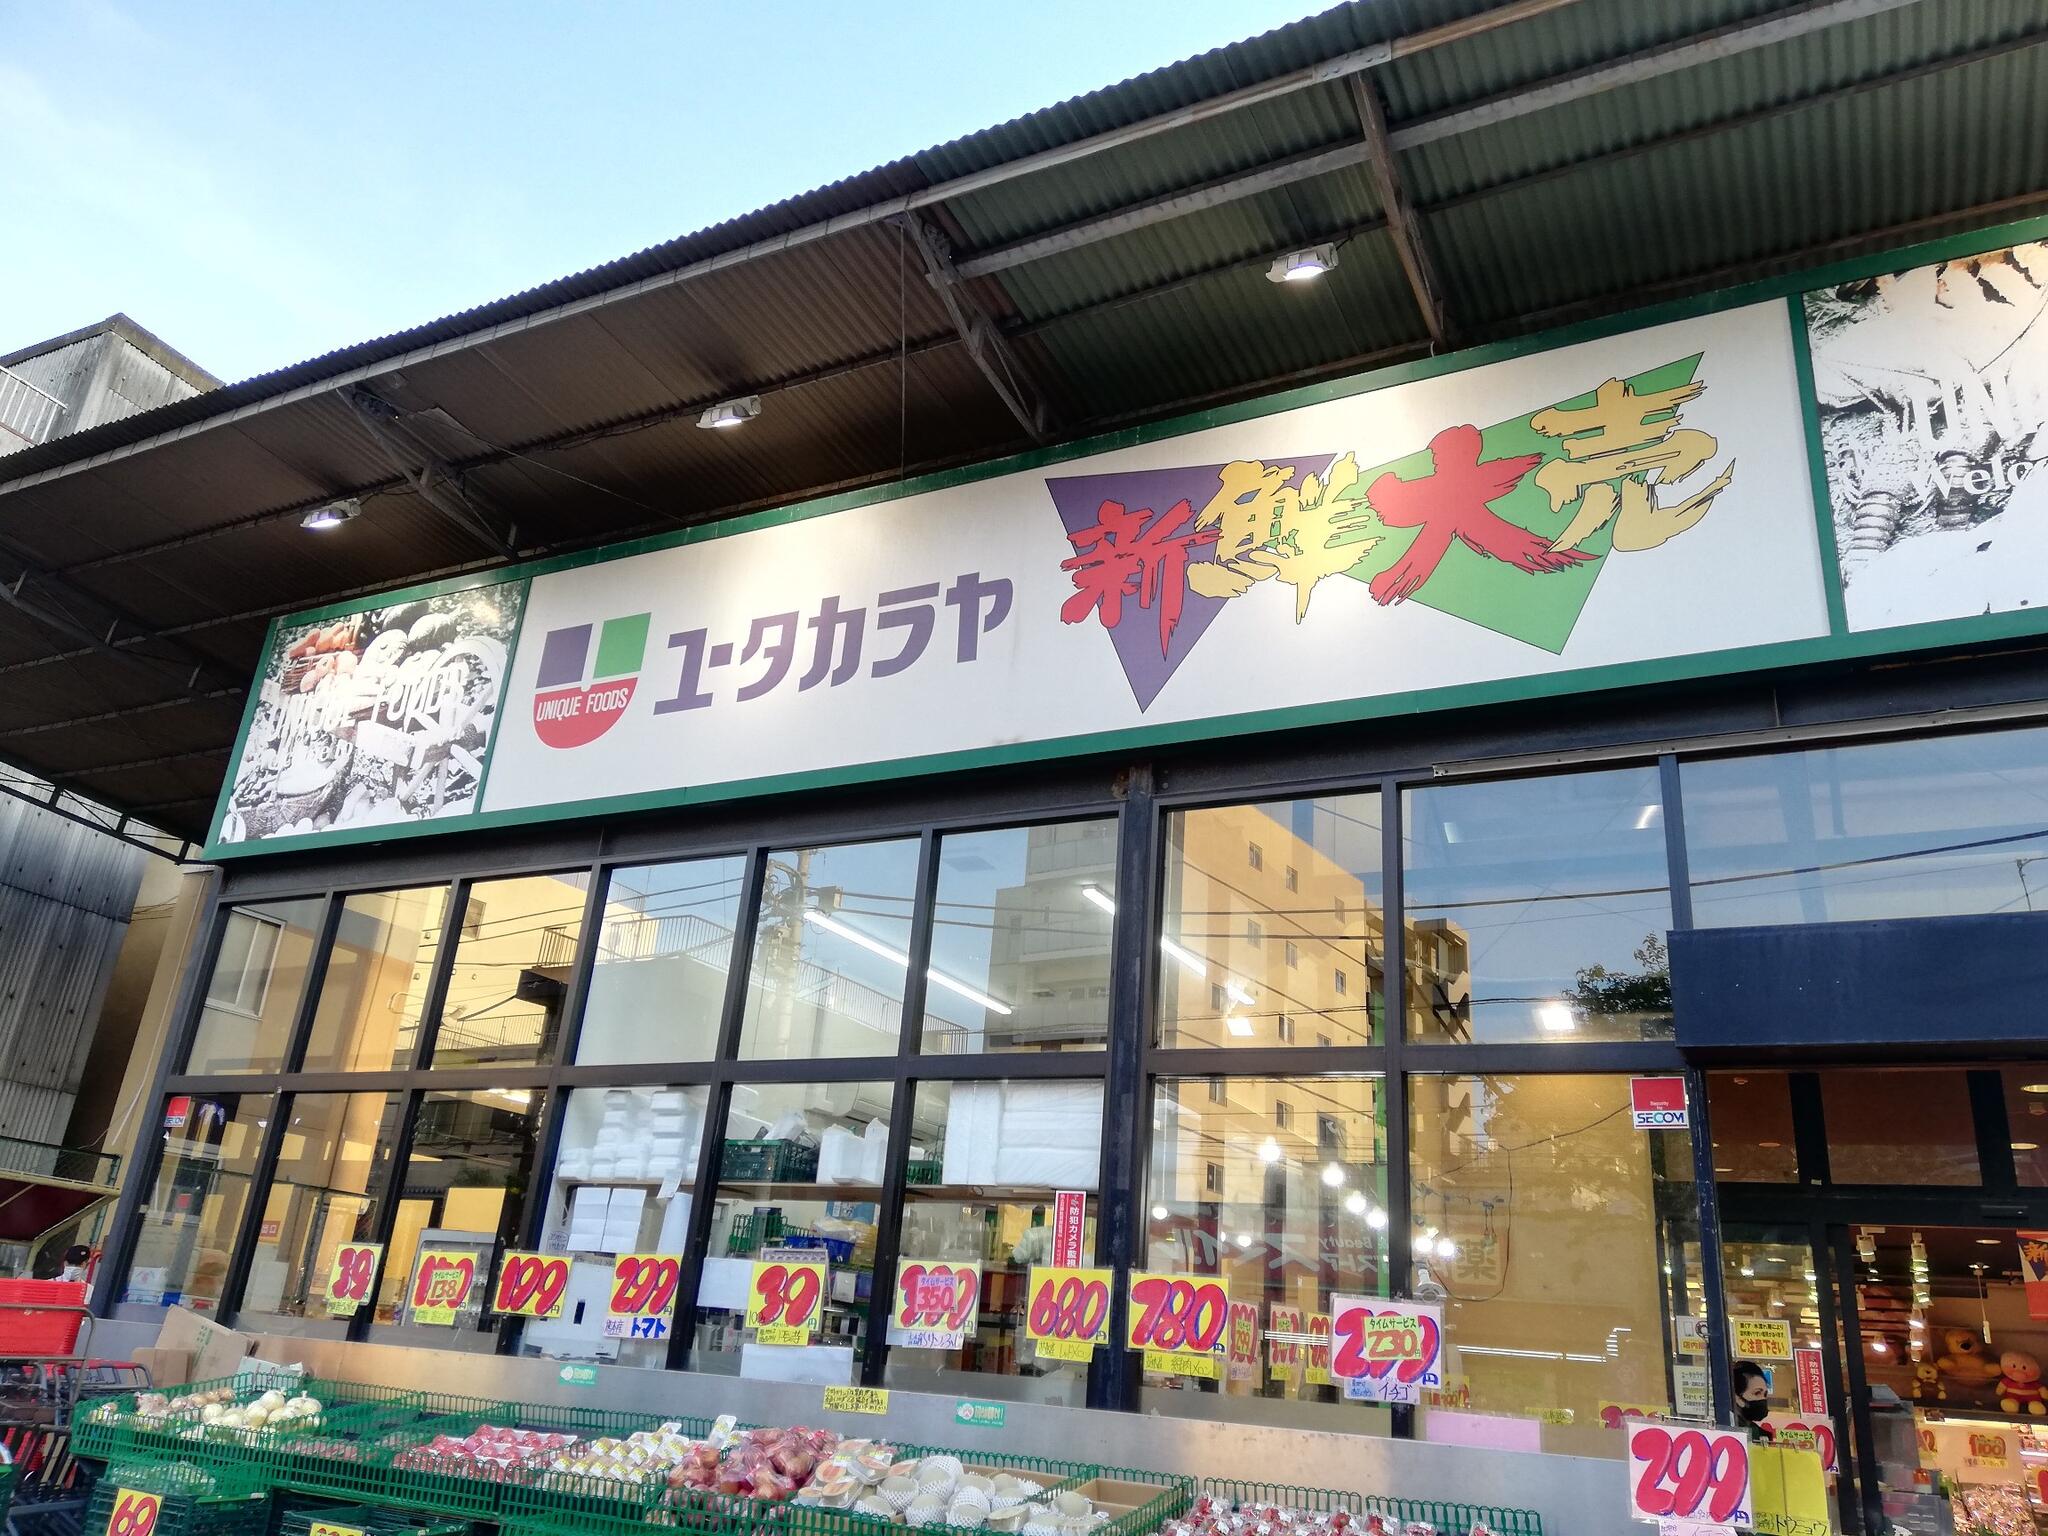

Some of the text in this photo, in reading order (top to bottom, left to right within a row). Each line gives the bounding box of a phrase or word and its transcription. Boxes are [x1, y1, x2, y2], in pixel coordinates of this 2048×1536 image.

[653, 572, 1014, 715] ユータカラヤ
[536, 688, 628, 721] UNIQUE FOODS
[1637, 1112, 1684, 1123] SECOM
[332, 1248, 374, 1300] 39
[431, 1279, 457, 1298] 138
[497, 1256, 568, 1315] 199
[611, 1257, 680, 1314] 299
[757, 1266, 820, 1327] 39
[917, 1287, 954, 1311] 350
[1029, 1277, 1109, 1339] 680
[631, 1317, 666, 1338] トマト
[1131, 1279, 1228, 1350] 780
[1369, 1318, 1417, 1328] タイムサービス
[1368, 1329, 1418, 1357] 230
[1379, 1381, 1413, 1401] イチゴ
[1422, 1373, 1439, 1385] 円
[1809, 1361, 1823, 1413] 防犯カメラ監視中
[1780, 1431, 1814, 1440] タイムサービス
[1631, 1427, 1748, 1523] 299
